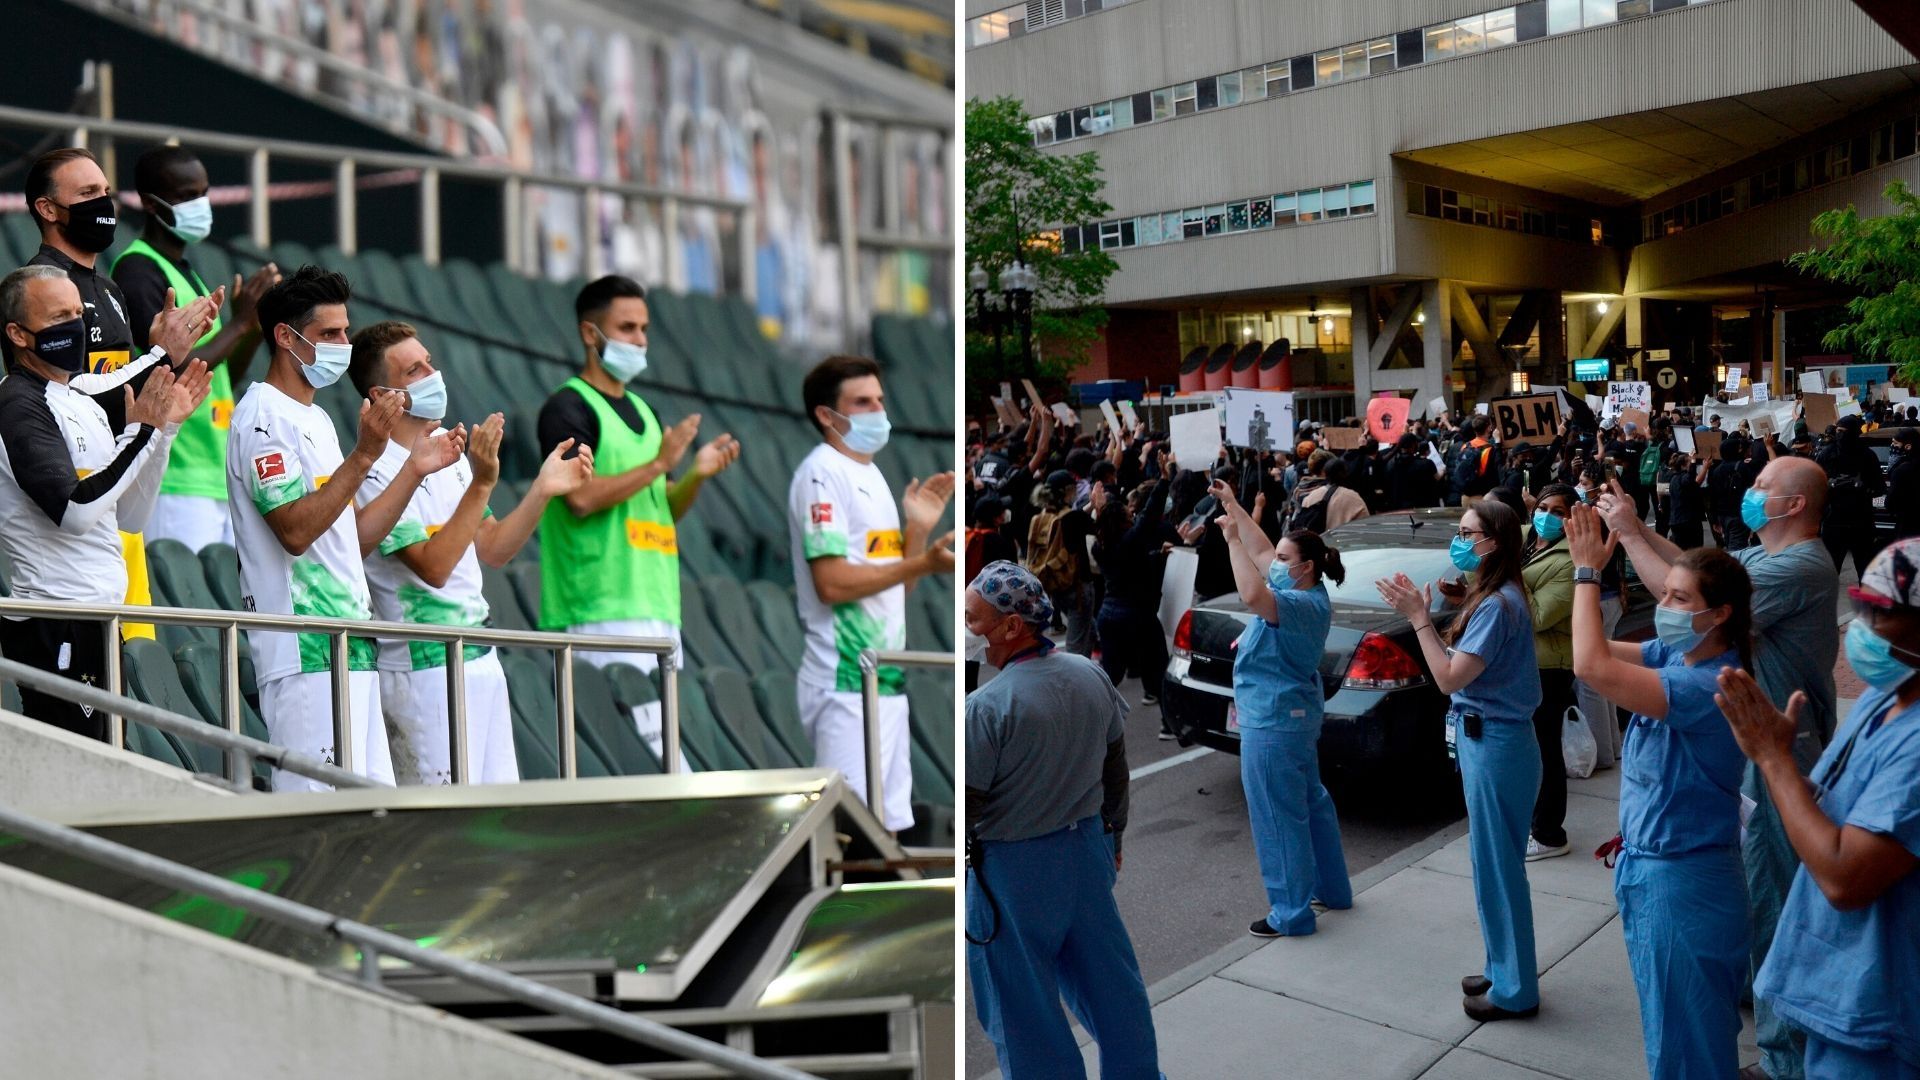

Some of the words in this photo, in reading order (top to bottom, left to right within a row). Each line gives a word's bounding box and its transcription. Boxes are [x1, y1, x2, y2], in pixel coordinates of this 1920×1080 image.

[90, 326, 103, 343] 22
[1660, 371, 1674, 385] T
[1611, 384, 1635, 395] Black
[1618, 394, 1641, 403] Lives
[1498, 401, 1558, 441] BLM
[76, 436, 87, 453] FG
